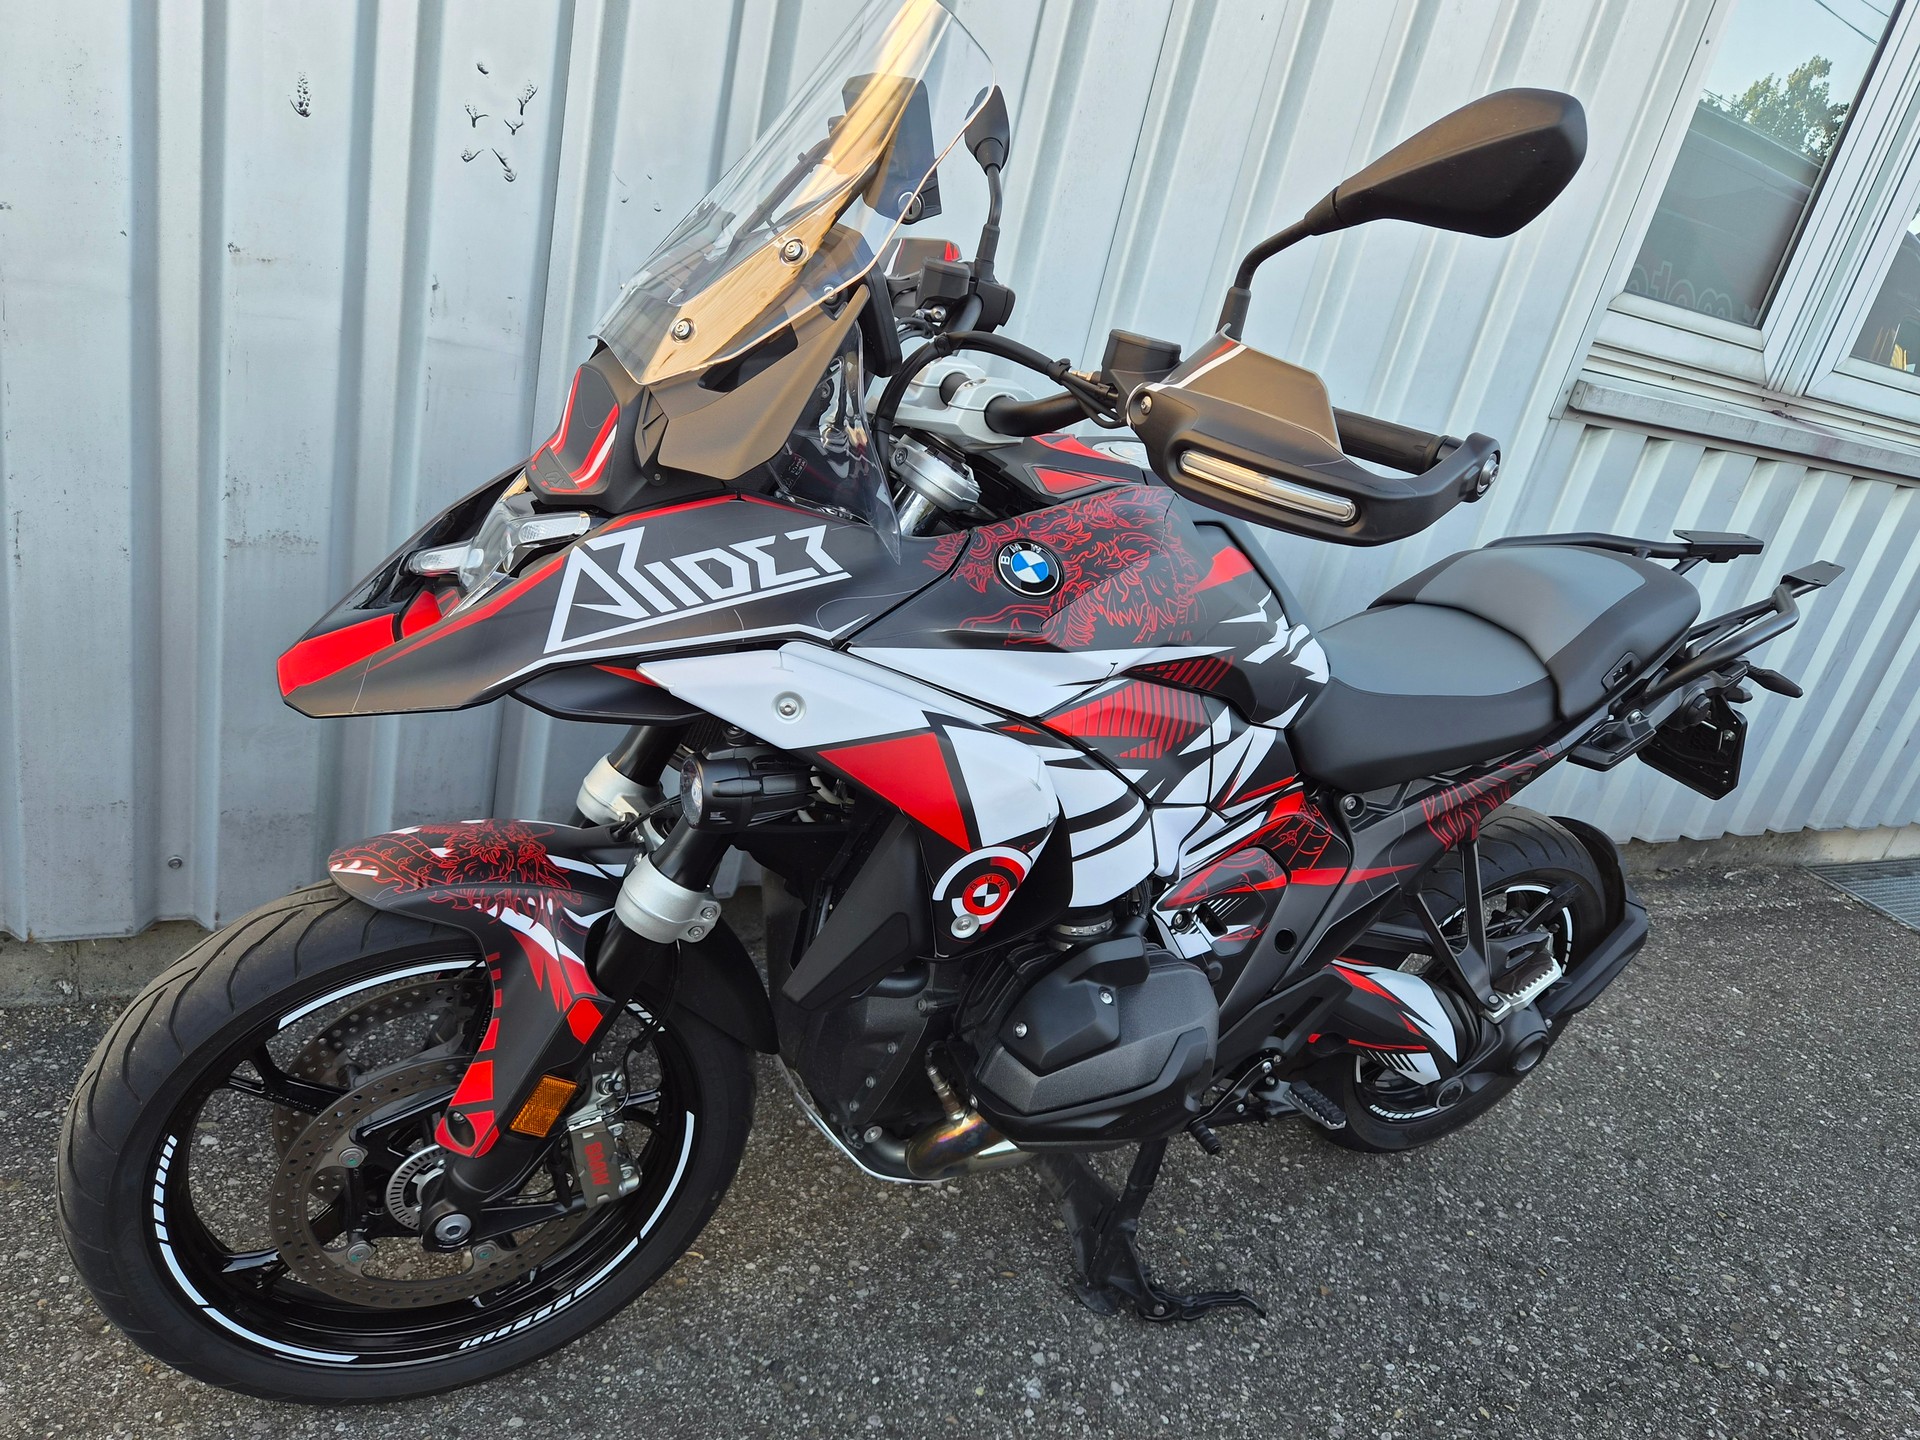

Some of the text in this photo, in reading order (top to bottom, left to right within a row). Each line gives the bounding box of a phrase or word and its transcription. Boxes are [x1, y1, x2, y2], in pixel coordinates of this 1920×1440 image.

[1000, 543, 1042, 565] BMW
[969, 875, 1006, 891] BMW
[584, 1141, 612, 1186] BMW
